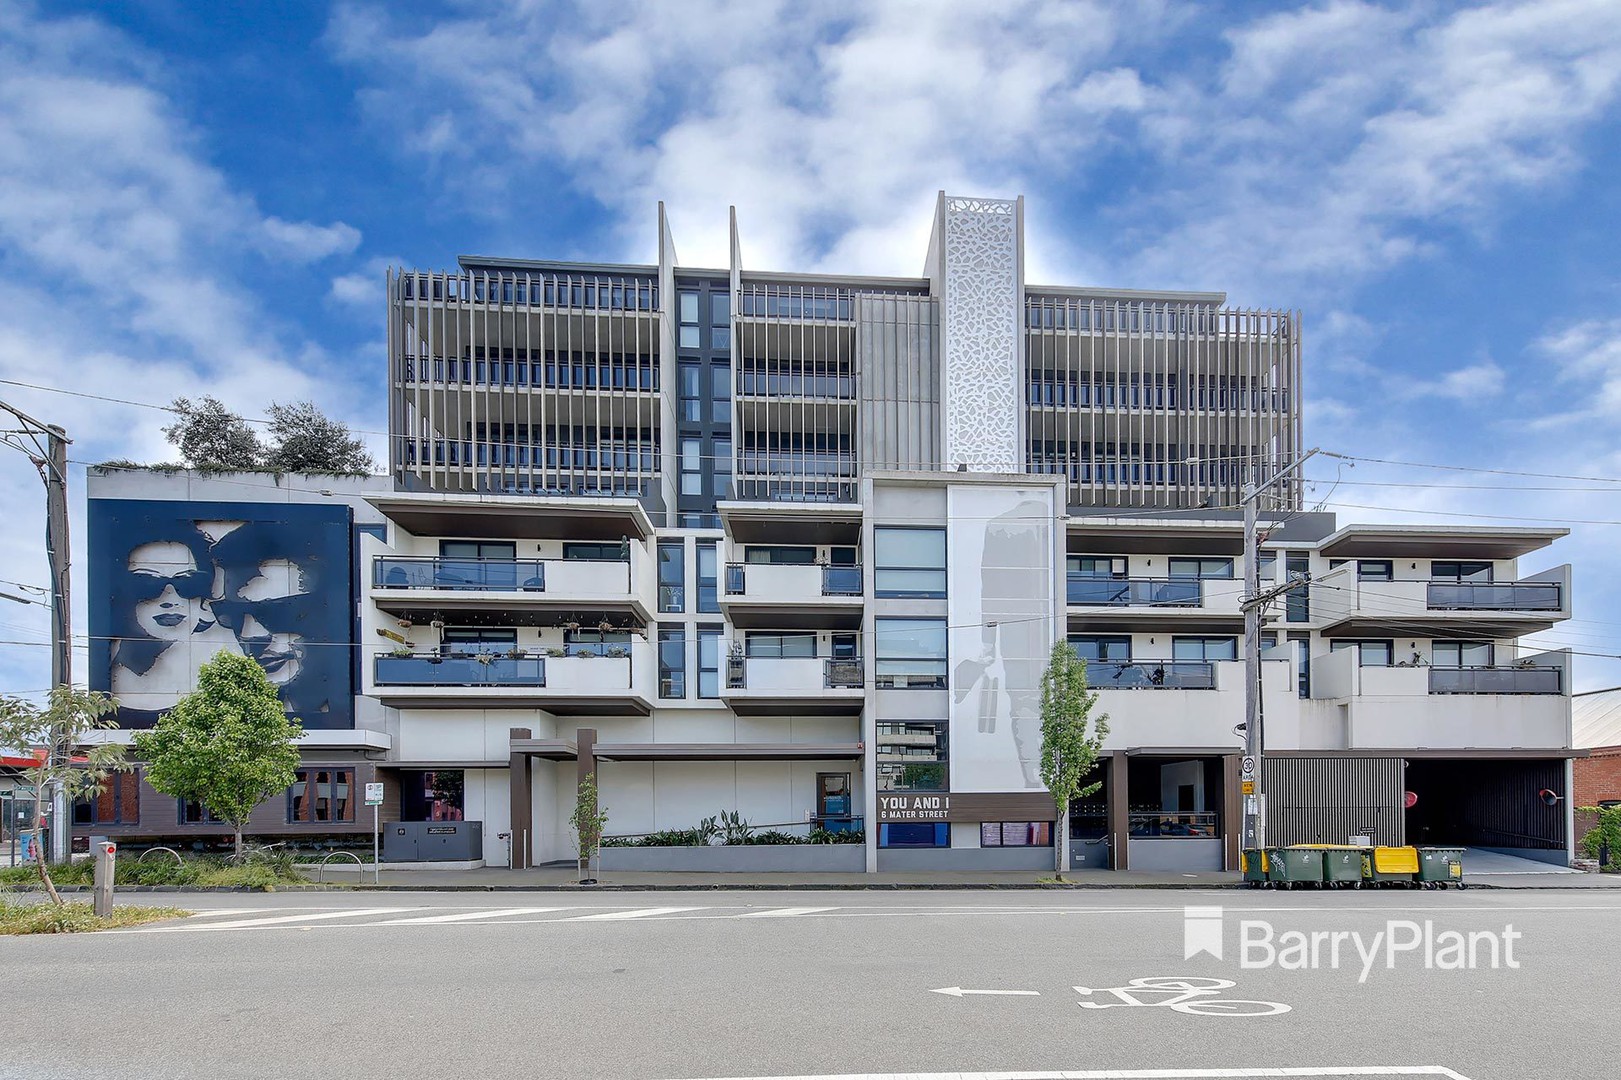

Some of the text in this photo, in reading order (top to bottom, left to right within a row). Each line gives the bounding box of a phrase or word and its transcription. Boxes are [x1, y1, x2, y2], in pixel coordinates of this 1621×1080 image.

[880, 797, 949, 809] YOU AND I
[881, 810, 949, 818] 6 MATER STREET
